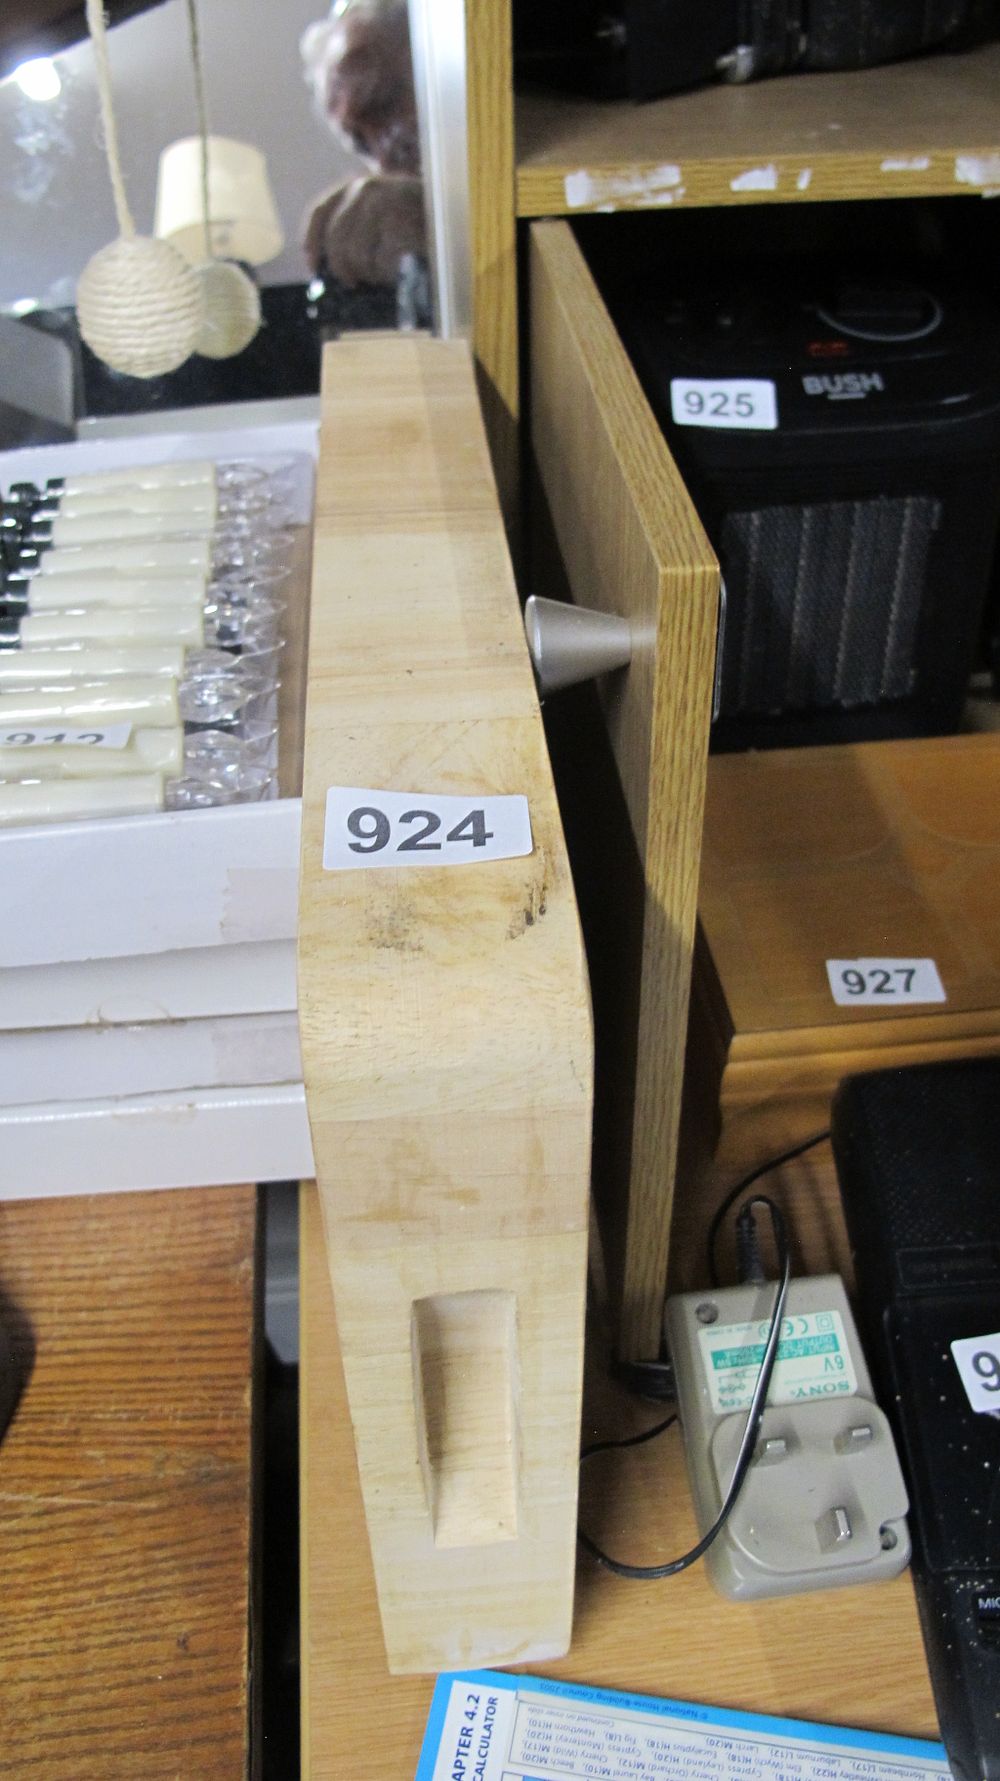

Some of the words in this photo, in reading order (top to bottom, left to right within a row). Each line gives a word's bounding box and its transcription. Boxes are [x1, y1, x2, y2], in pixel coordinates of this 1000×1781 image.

[802, 372, 885, 396] BUSH
[684, 390, 754, 417] 925
[346, 806, 495, 854] 924
[841, 968, 916, 995] 927
[796, 1380, 850, 1398] SONY
[464, 1693, 481, 1721] 4.2
[608, 1744, 642, 1758] Cypress
[672, 1744, 717, 1759] Eucalyptus
[735, 1743, 759, 1754] Larch
[727, 1765, 762, 1778] Cypress
